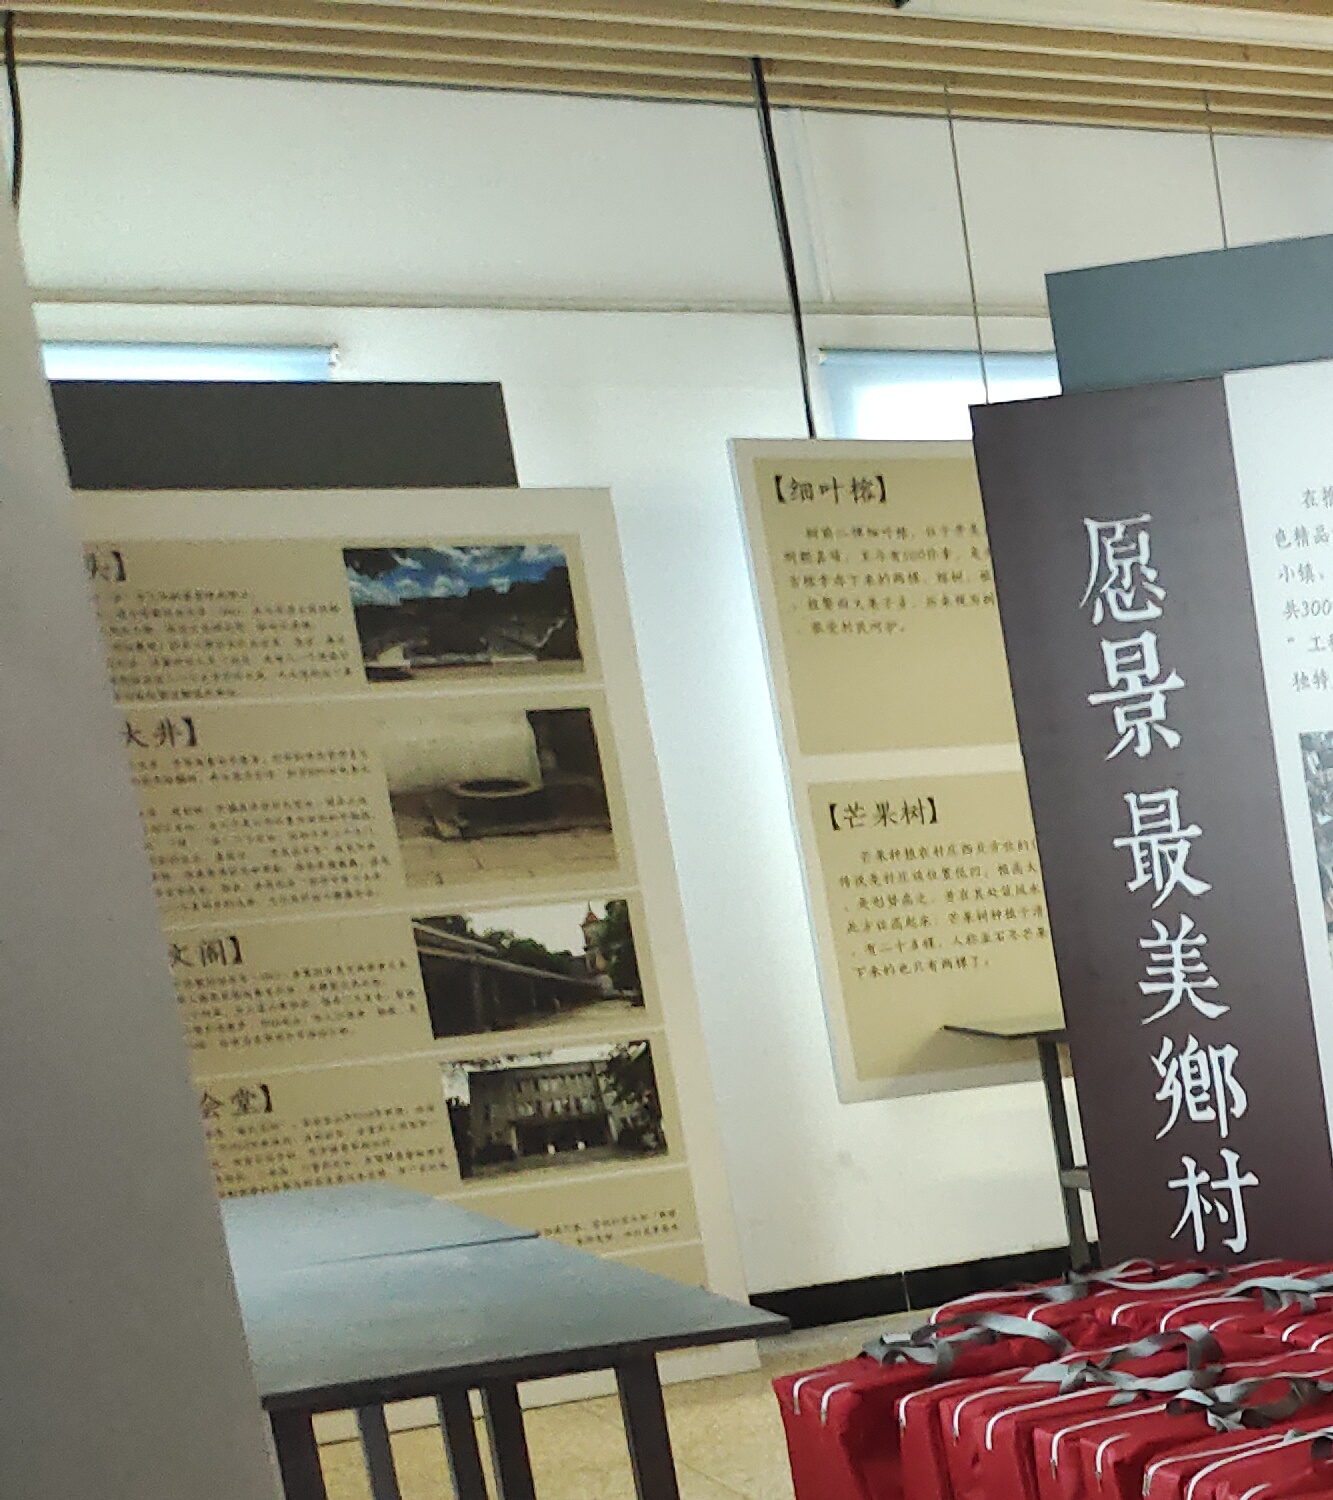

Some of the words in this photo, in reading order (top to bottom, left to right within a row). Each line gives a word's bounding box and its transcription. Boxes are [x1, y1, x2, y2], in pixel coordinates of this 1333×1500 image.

[774, 475, 887, 503] 【细叶榕】
[828, 797, 939, 831] 【芒果树】
